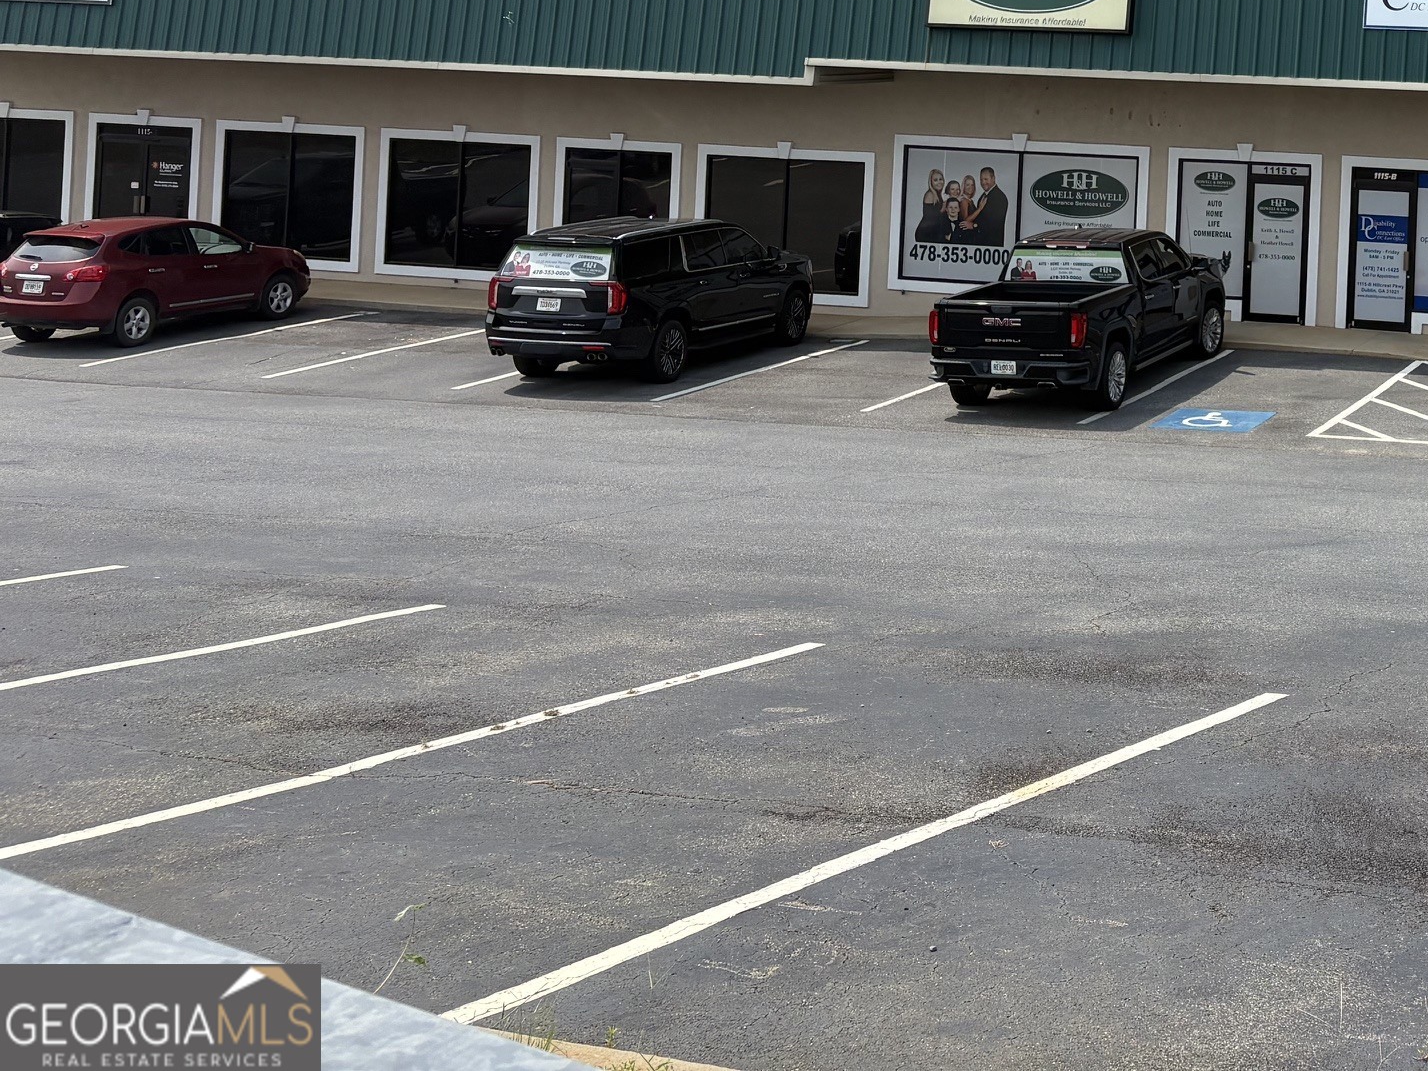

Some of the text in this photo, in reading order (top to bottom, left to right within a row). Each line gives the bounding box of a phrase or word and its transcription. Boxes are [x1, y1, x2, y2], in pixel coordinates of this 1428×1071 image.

[968, 15, 1087, 26] Making Insurance Affordable!
[160, 162, 183, 171] Hanger
[1035, 190, 1074, 199] HOWELL
[1085, 192, 1123, 201] HOWELL
[1194, 230, 1232, 238] COMMERCIAL
[910, 244, 1010, 265] 478-353-0000
[982, 317, 1021, 326] GMC
